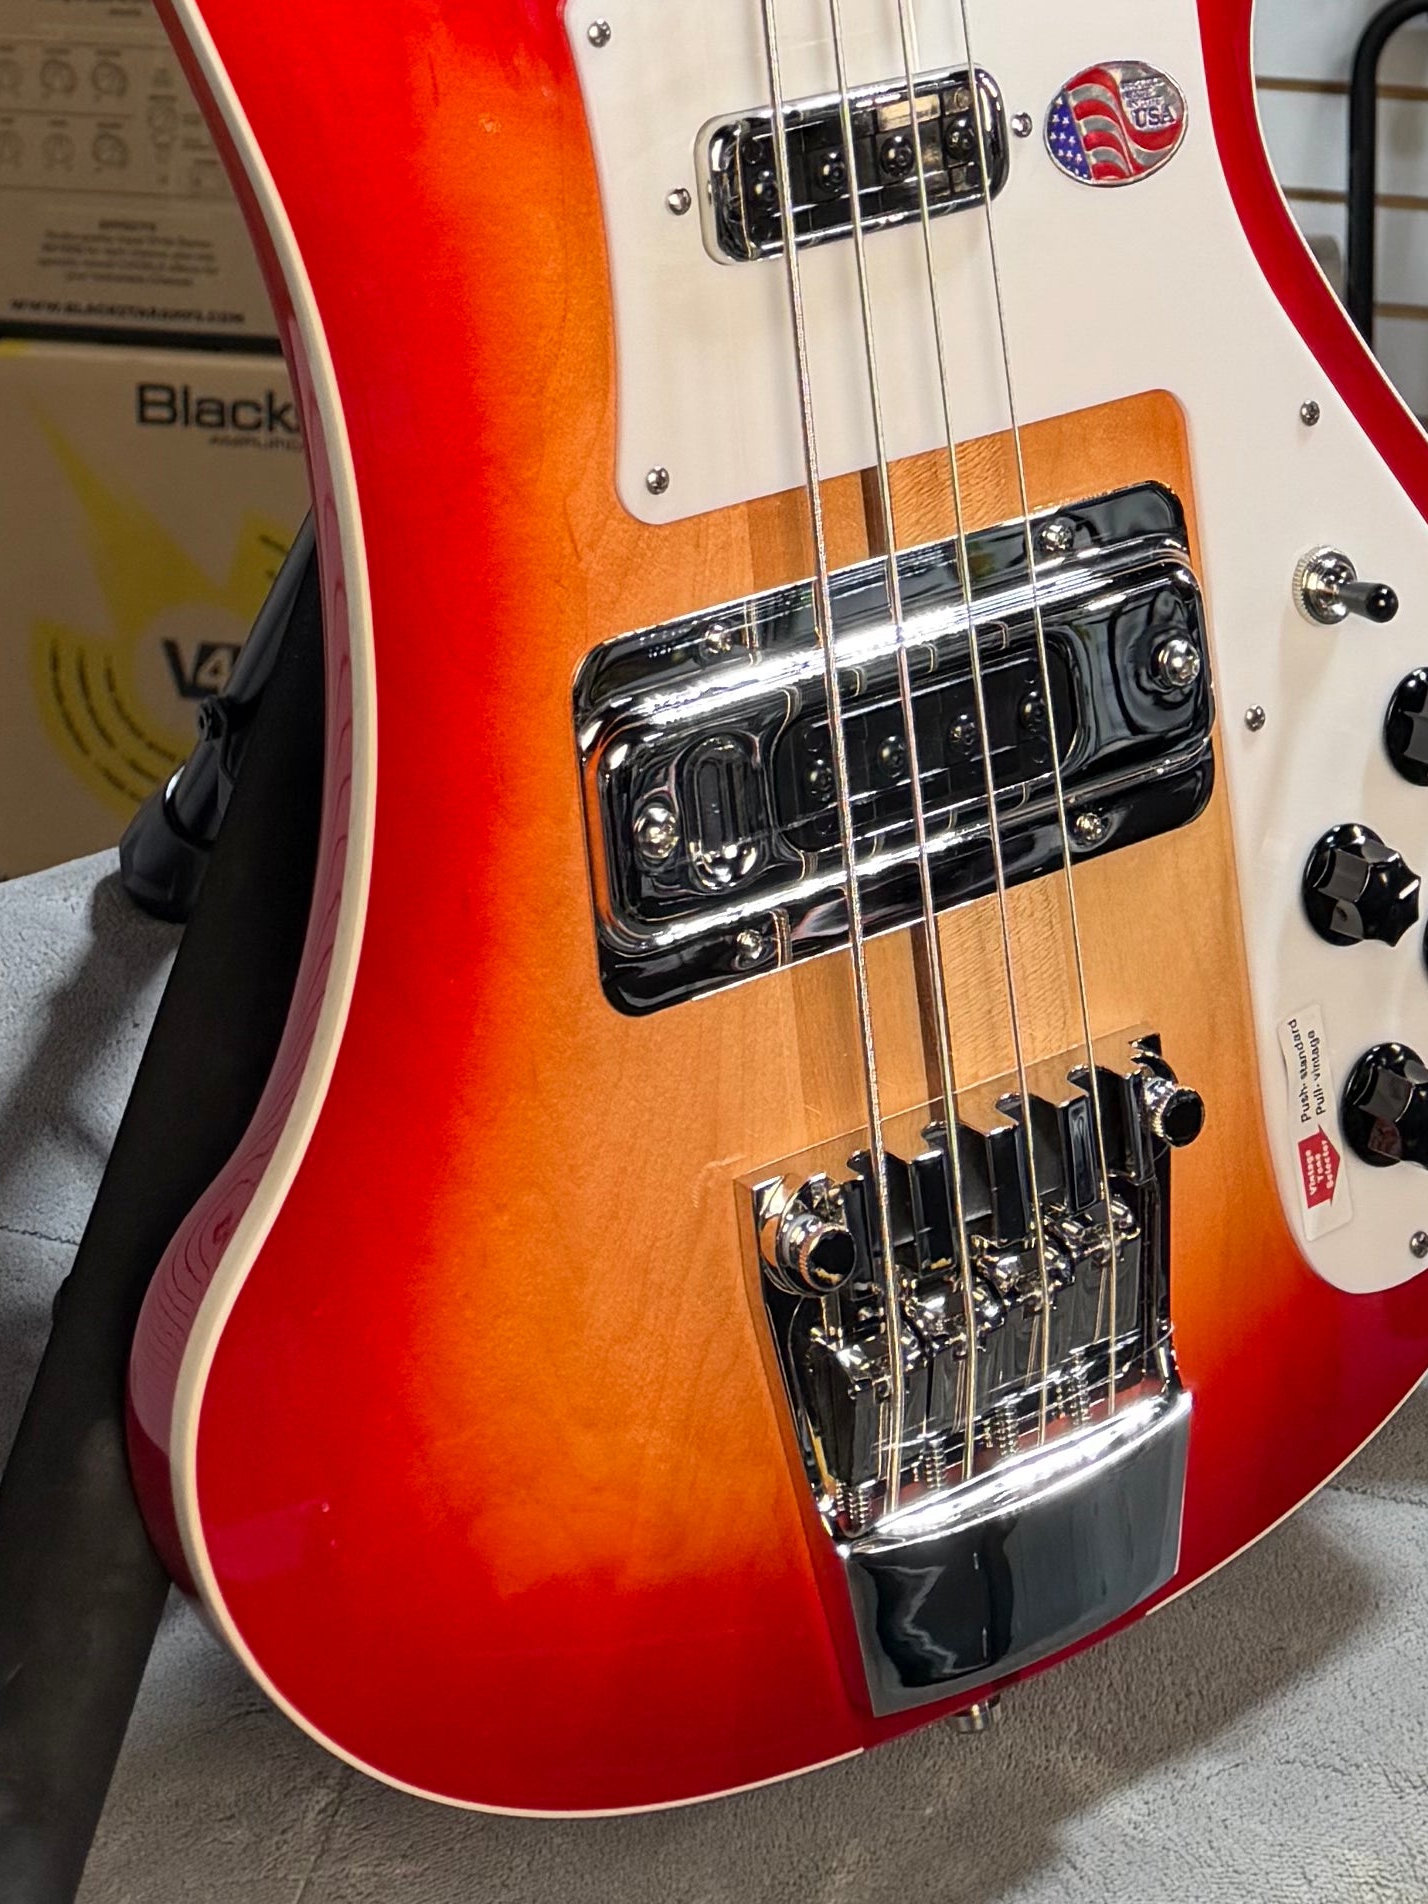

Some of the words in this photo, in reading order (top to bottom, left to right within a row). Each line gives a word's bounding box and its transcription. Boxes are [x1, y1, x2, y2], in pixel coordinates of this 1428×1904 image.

[1132, 106, 1176, 129] USA
[1287, 1018, 1309, 1081] standard
[1307, 1029, 1323, 1081] vintage
